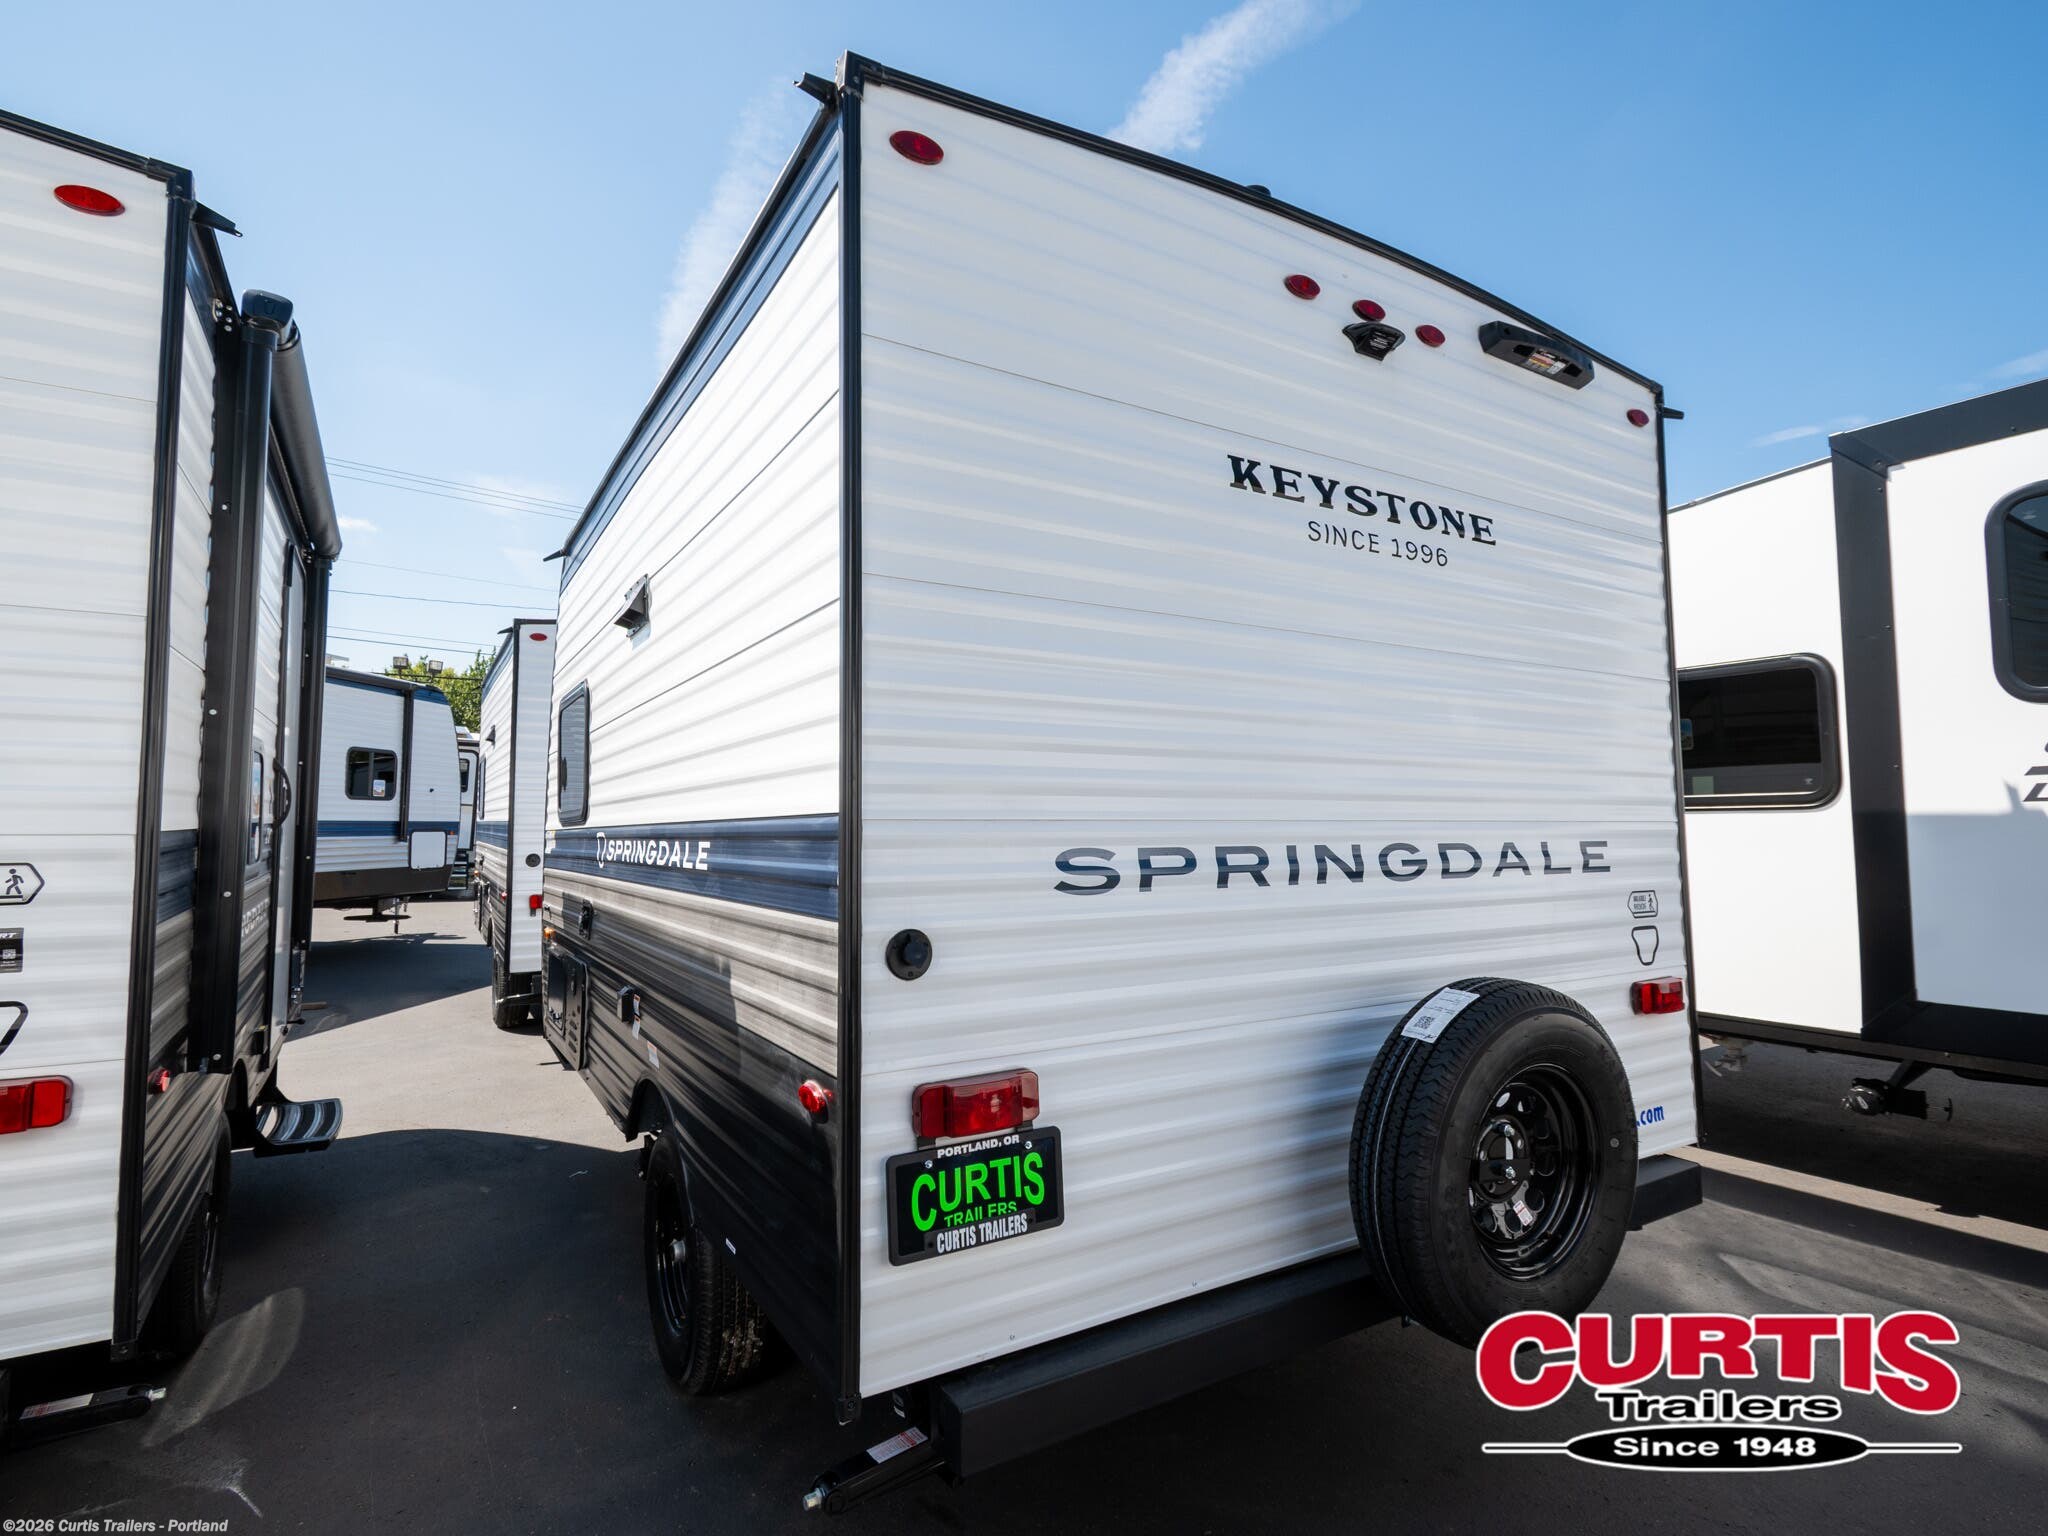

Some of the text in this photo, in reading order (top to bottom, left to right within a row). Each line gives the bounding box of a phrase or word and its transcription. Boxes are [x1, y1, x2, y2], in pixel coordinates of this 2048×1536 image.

[1227, 454, 1496, 546] KEYSTONE
[1307, 520, 1448, 567] SINCE 1996
[606, 839, 711, 871] SPRINGDALE
[1053, 840, 1612, 896] SPRINGDALE
[1003, 1134, 1020, 1146] OR
[911, 1151, 1045, 1232] CURTIS
[936, 1212, 1028, 1254] CURTIS TRAILERS
